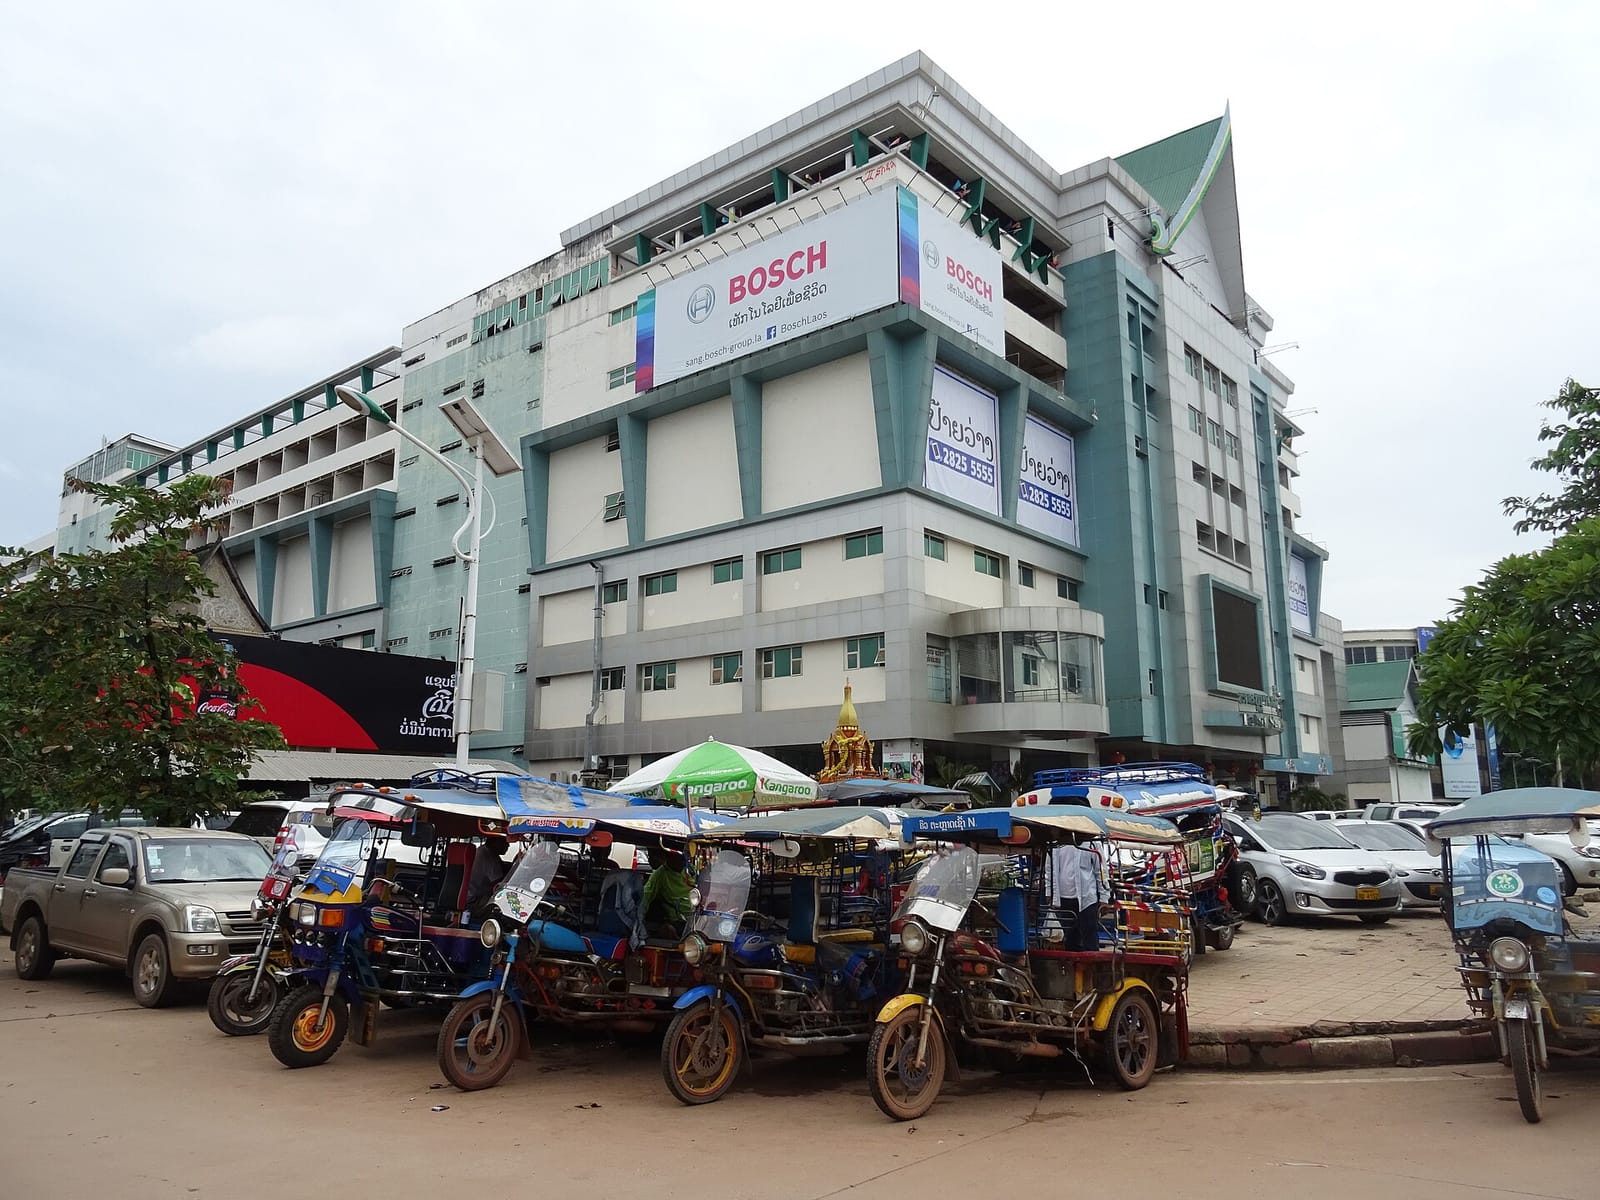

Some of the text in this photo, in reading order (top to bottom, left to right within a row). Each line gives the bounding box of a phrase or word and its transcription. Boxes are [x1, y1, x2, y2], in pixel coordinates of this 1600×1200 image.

[729, 240, 827, 305] BOSCH
[946, 256, 993, 303] BOSCH
[942, 449, 993, 484] 2825 5555
[1029, 487, 1071, 518] 2825 5555
[675, 778, 748, 797] Kangaroo
[762, 776, 811, 796] Kangaroo
